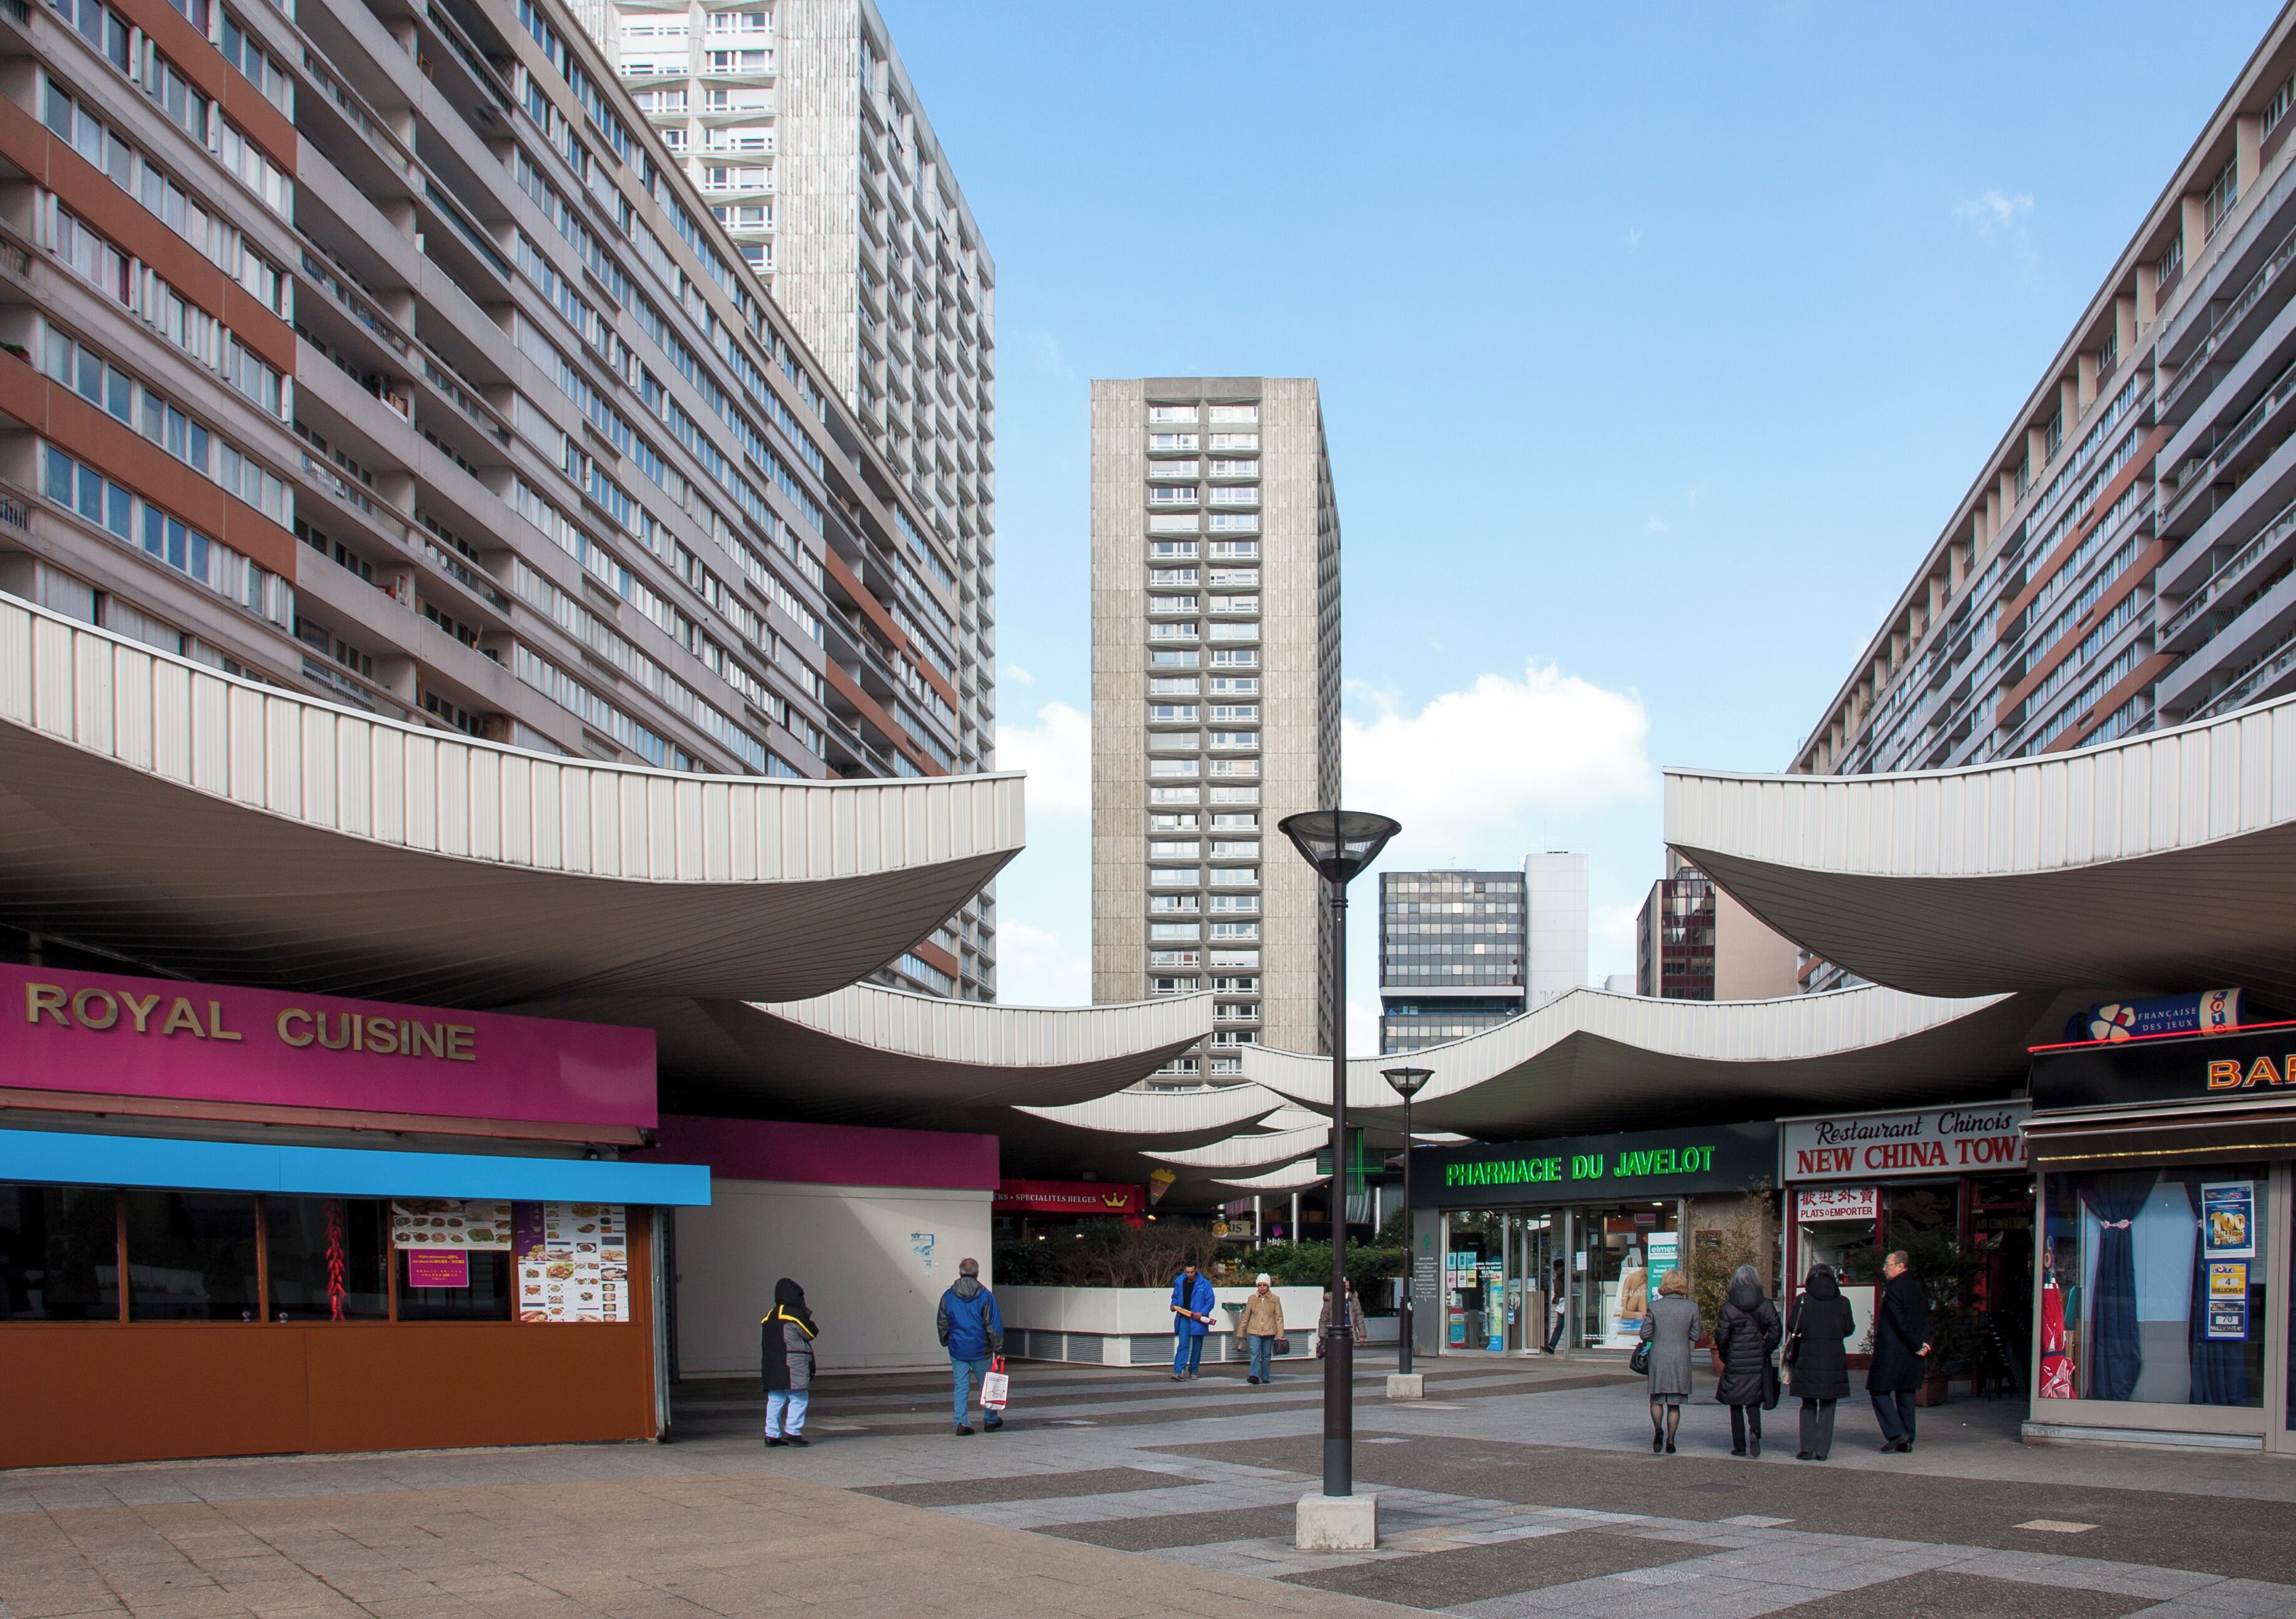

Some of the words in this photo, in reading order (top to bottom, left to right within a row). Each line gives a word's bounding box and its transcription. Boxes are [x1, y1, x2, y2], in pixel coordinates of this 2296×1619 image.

[25, 982, 243, 1041] ROYAL
[277, 1007, 477, 1062] CUISINE
[2137, 1006, 2197, 1021] FRANÇAISE
[2142, 1022, 2162, 1032] DES
[2166, 1019, 2194, 1031] JEUX
[1815, 1115, 1923, 1146] Restaurant
[1938, 1111, 2013, 1135] Chinois
[1446, 1156, 1562, 1187] PHARMACIE
[1572, 1153, 1604, 1180] DU
[1613, 1146, 1715, 1178] JAVELOT
[1796, 1146, 1858, 1174] NEW
[1864, 1141, 1949, 1170] CHINA
[1800, 1209, 1825, 1218] PLATS
[1830, 1206, 1873, 1217] EMPORTER
[2209, 1212, 2246, 1231] 100
[2222, 1315, 2233, 1323] 70
